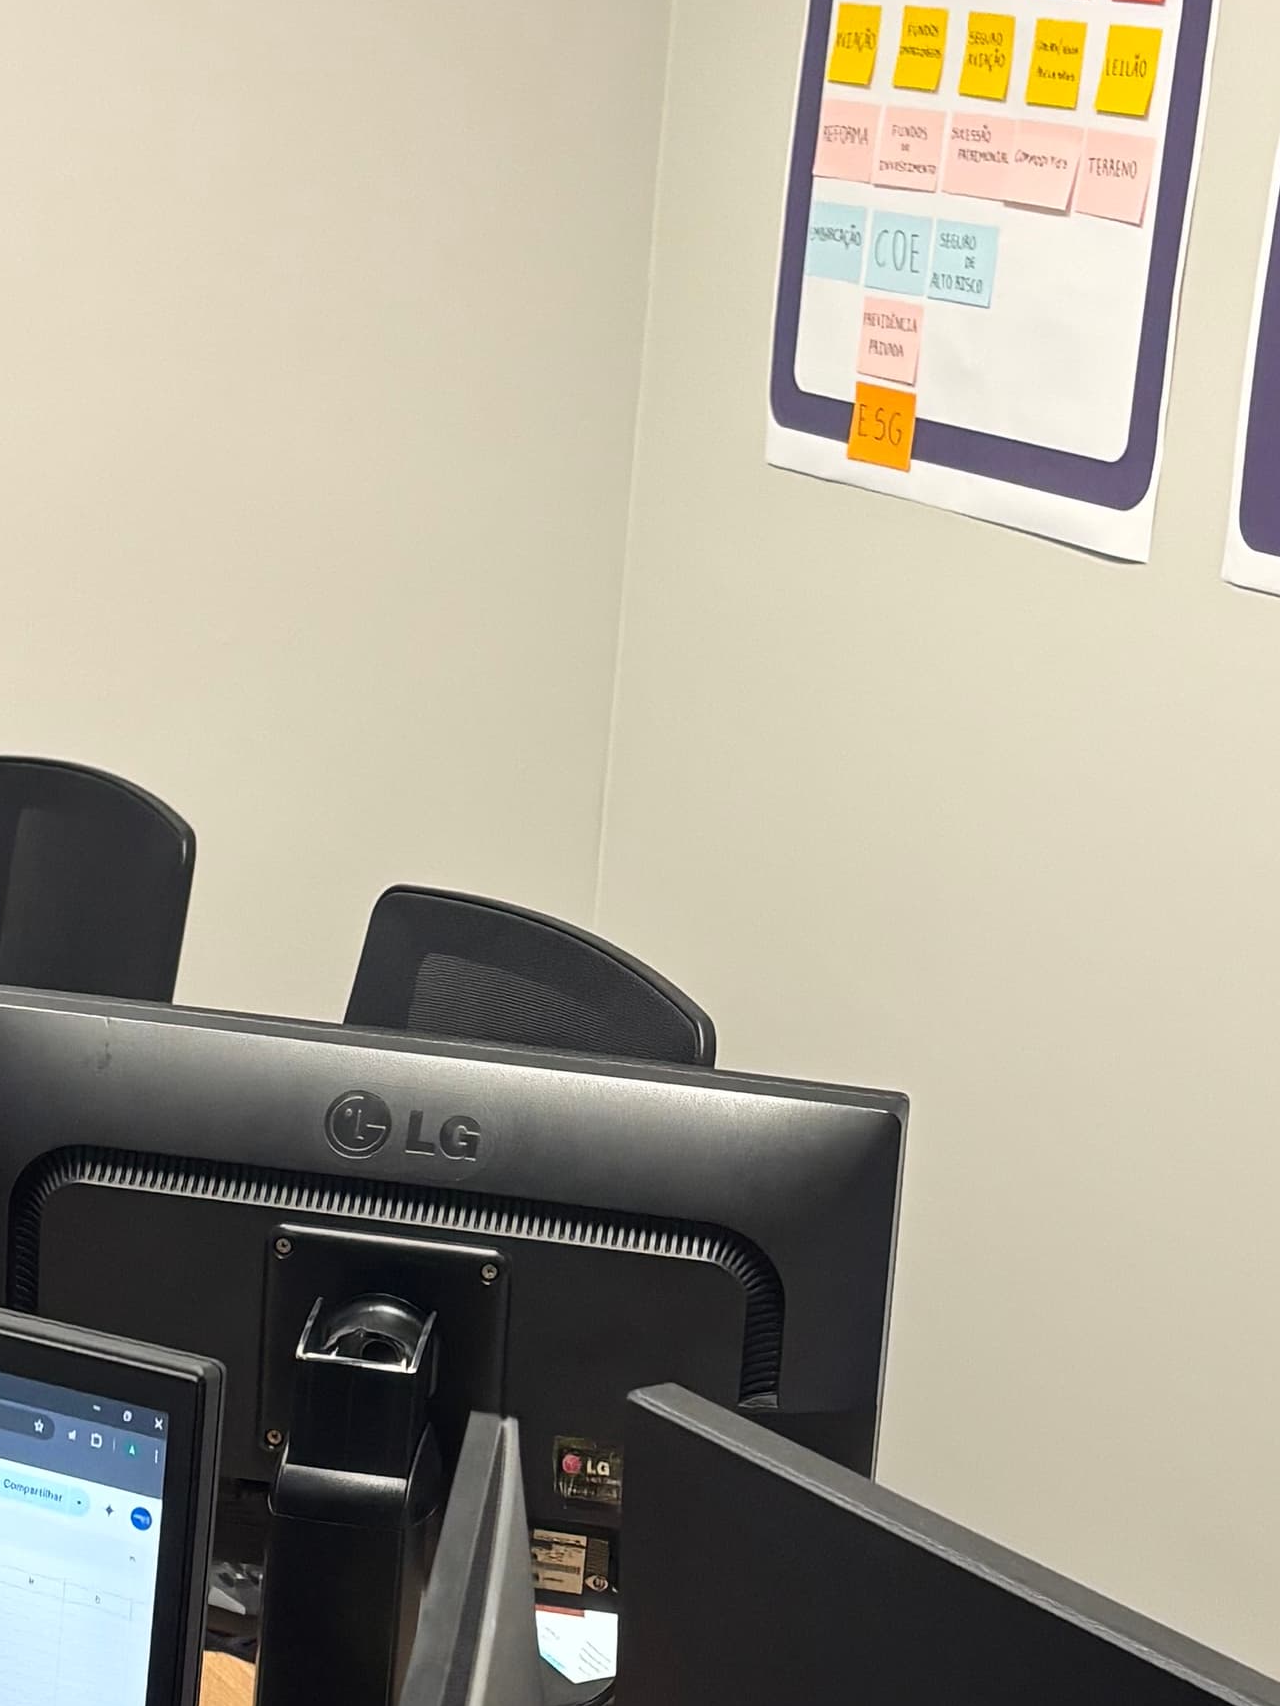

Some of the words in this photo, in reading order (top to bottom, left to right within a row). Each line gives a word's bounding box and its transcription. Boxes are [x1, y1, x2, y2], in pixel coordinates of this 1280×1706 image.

[907, 23, 939, 37] FUNDOS
[968, 31, 1003, 46] SEGURO
[1105, 54, 1147, 79] LEILÃO
[823, 124, 869, 146] REFORMA
[891, 124, 928, 141] FUNDOS
[1088, 156, 1138, 180] TERRENO
[874, 229, 920, 274] COE
[939, 232, 977, 251] SEGURO
[964, 255, 976, 269] DE
[930, 272, 954, 290] ALTO
[954, 275, 984, 294] RISCO
[868, 339, 904, 358] PRIVADA
[857, 402, 903, 447] ESG
[404, 1109, 483, 1163] LG
[586, 1458, 610, 1477] LG
[3, 1478, 64, 1504] Compartilhar
